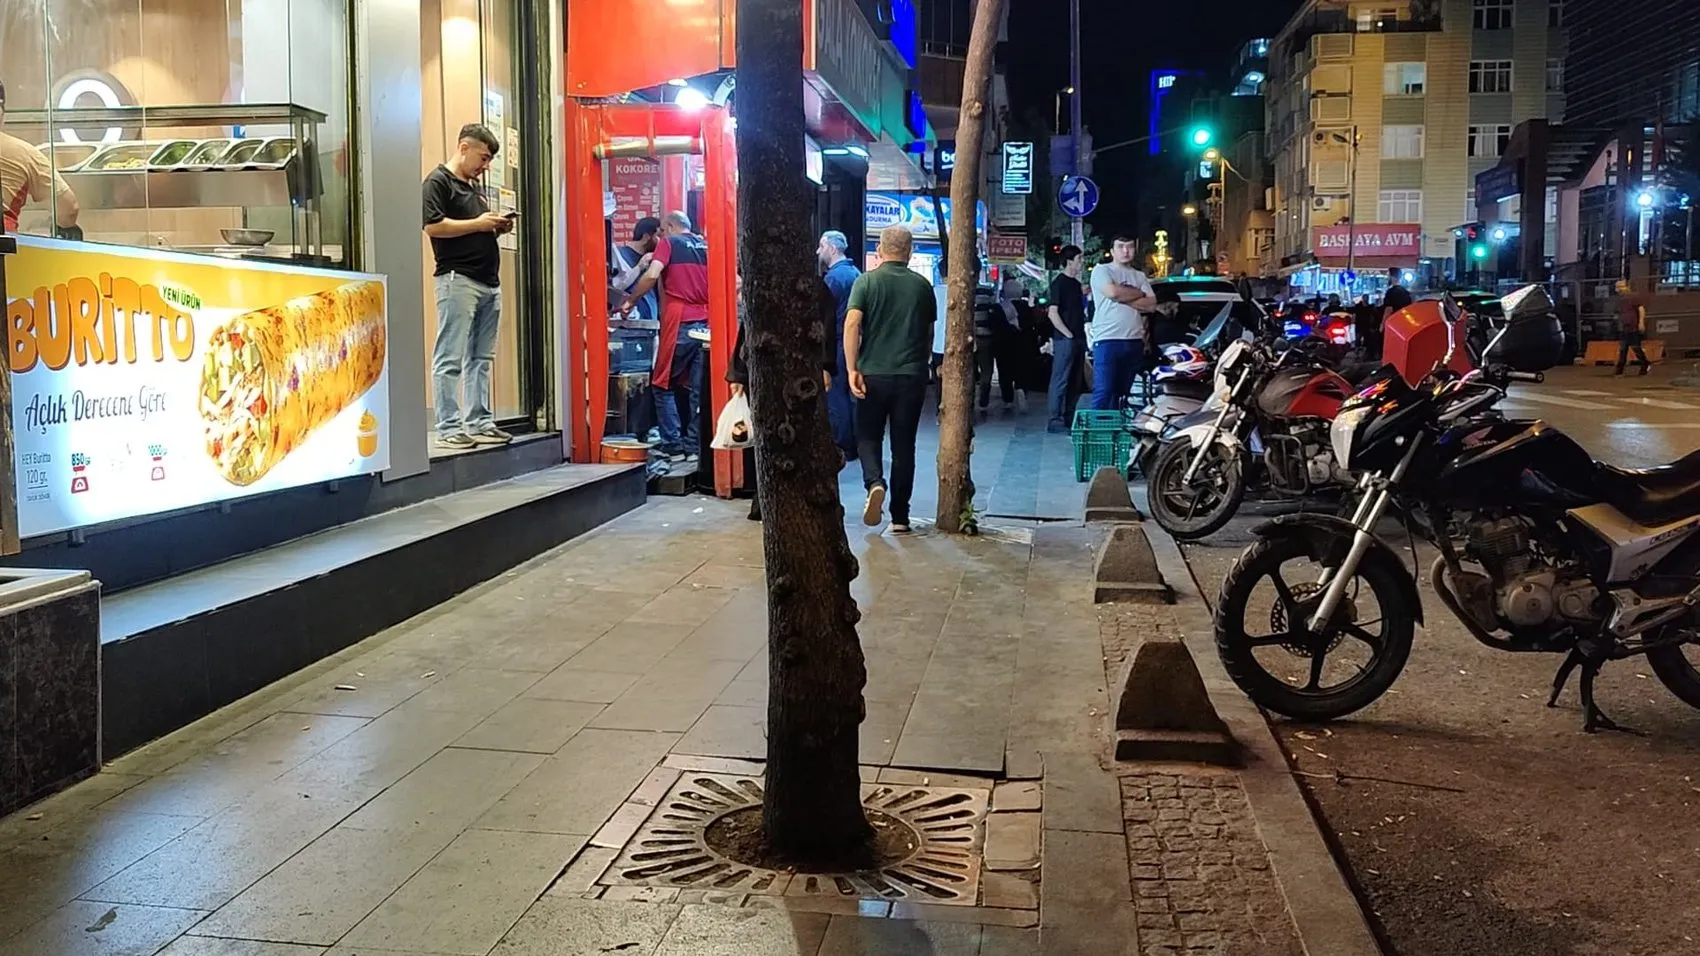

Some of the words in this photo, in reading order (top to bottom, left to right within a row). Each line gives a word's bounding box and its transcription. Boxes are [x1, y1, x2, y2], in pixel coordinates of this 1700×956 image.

[615, 164, 659, 174] KOKORE
[991, 239, 1024, 247] FOTO
[1384, 232, 1414, 246] AVM
[163, 285, 180, 303] YENİ
[181, 290, 201, 311] ÜRÜN
[25, 393, 67, 435] Açlık
[27, 469, 38, 484] 120
